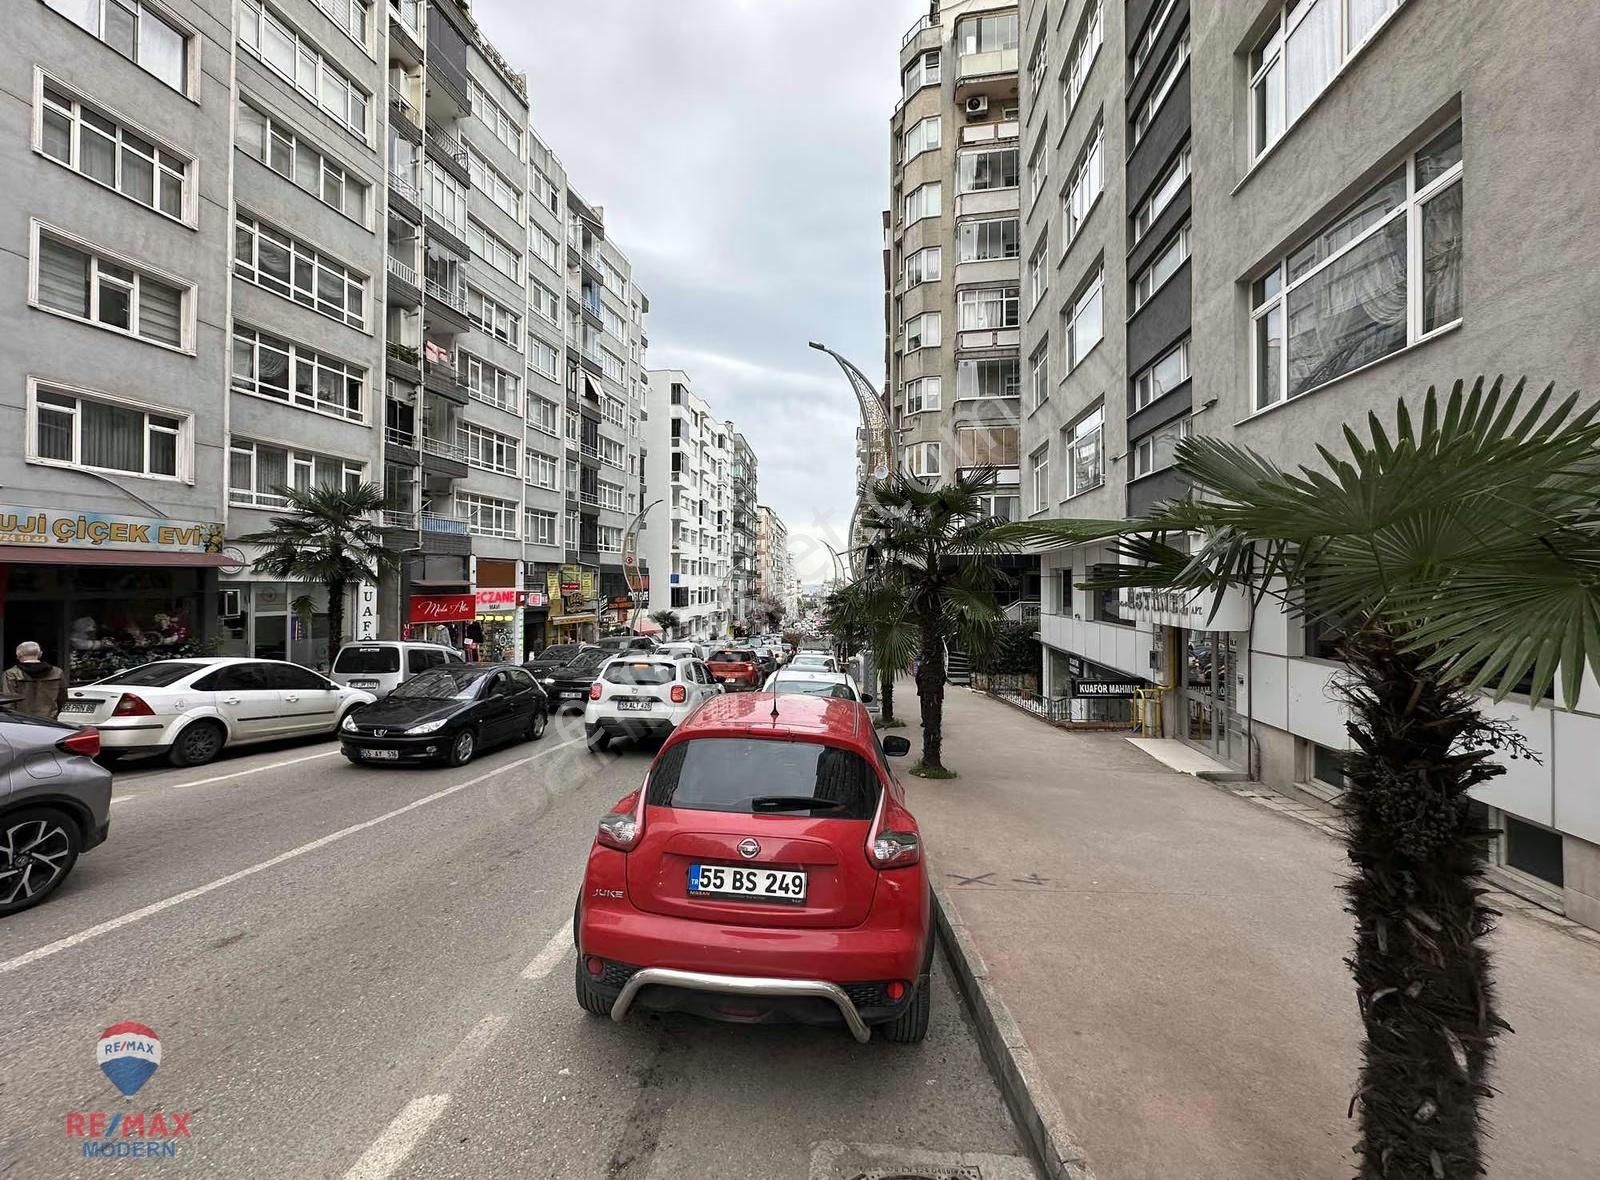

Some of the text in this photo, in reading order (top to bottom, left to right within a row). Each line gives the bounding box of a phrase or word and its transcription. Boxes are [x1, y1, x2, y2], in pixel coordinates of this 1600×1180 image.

[52, 516, 150, 544] ÇİÇEK
[158, 525, 200, 546] EVİ
[592, 888, 624, 898] JUKE
[699, 867, 803, 895] 55 BS 249
